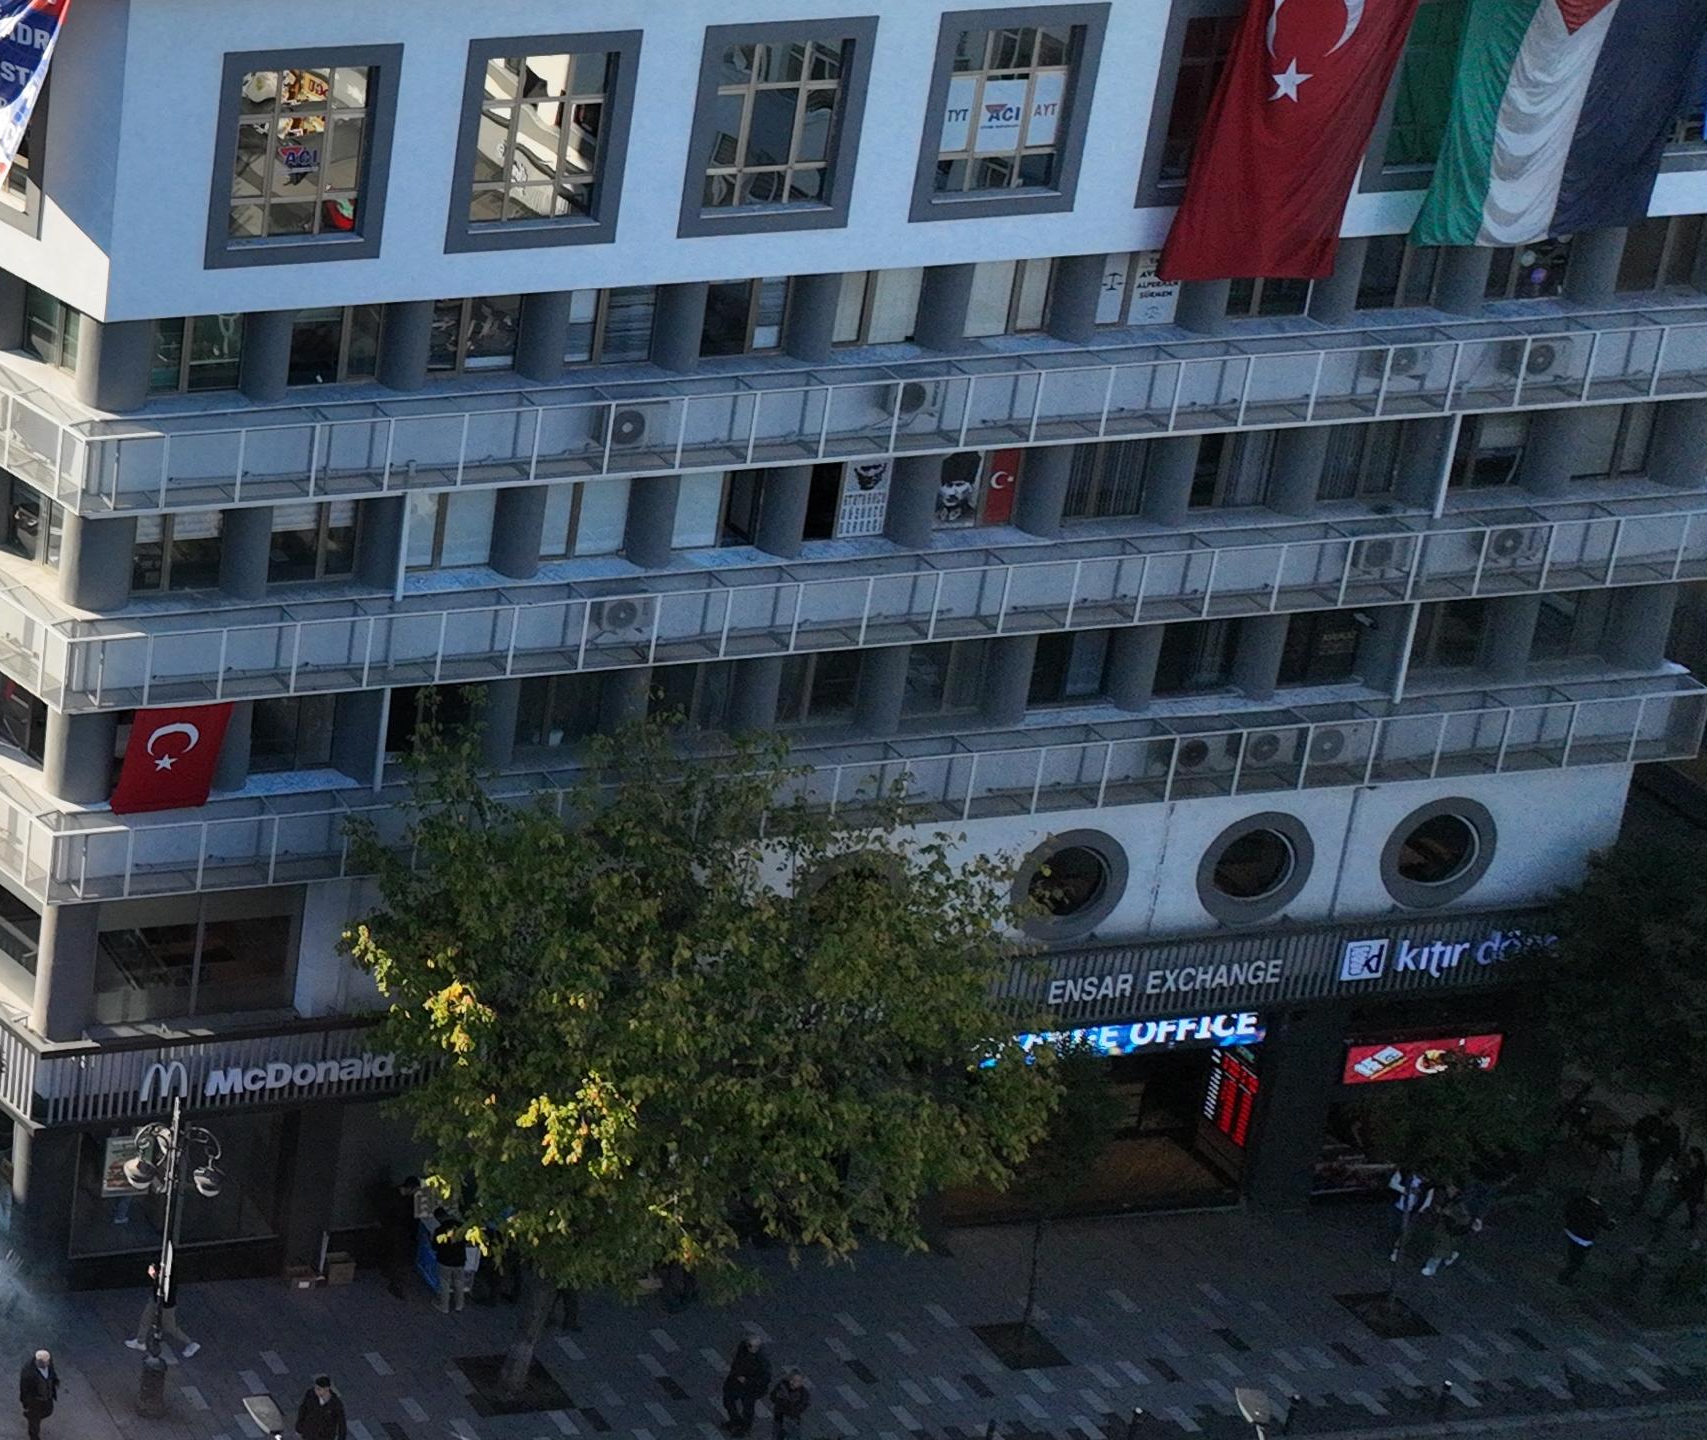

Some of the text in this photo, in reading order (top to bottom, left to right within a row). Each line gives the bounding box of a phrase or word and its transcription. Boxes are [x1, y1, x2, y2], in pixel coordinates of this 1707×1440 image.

[947, 108, 969, 123] TYT
[1033, 103, 1058, 117] AYT
[1047, 959, 1284, 1006] ENSAR EXCHANGE
[1128, 1011, 1260, 1046] OFFICE
